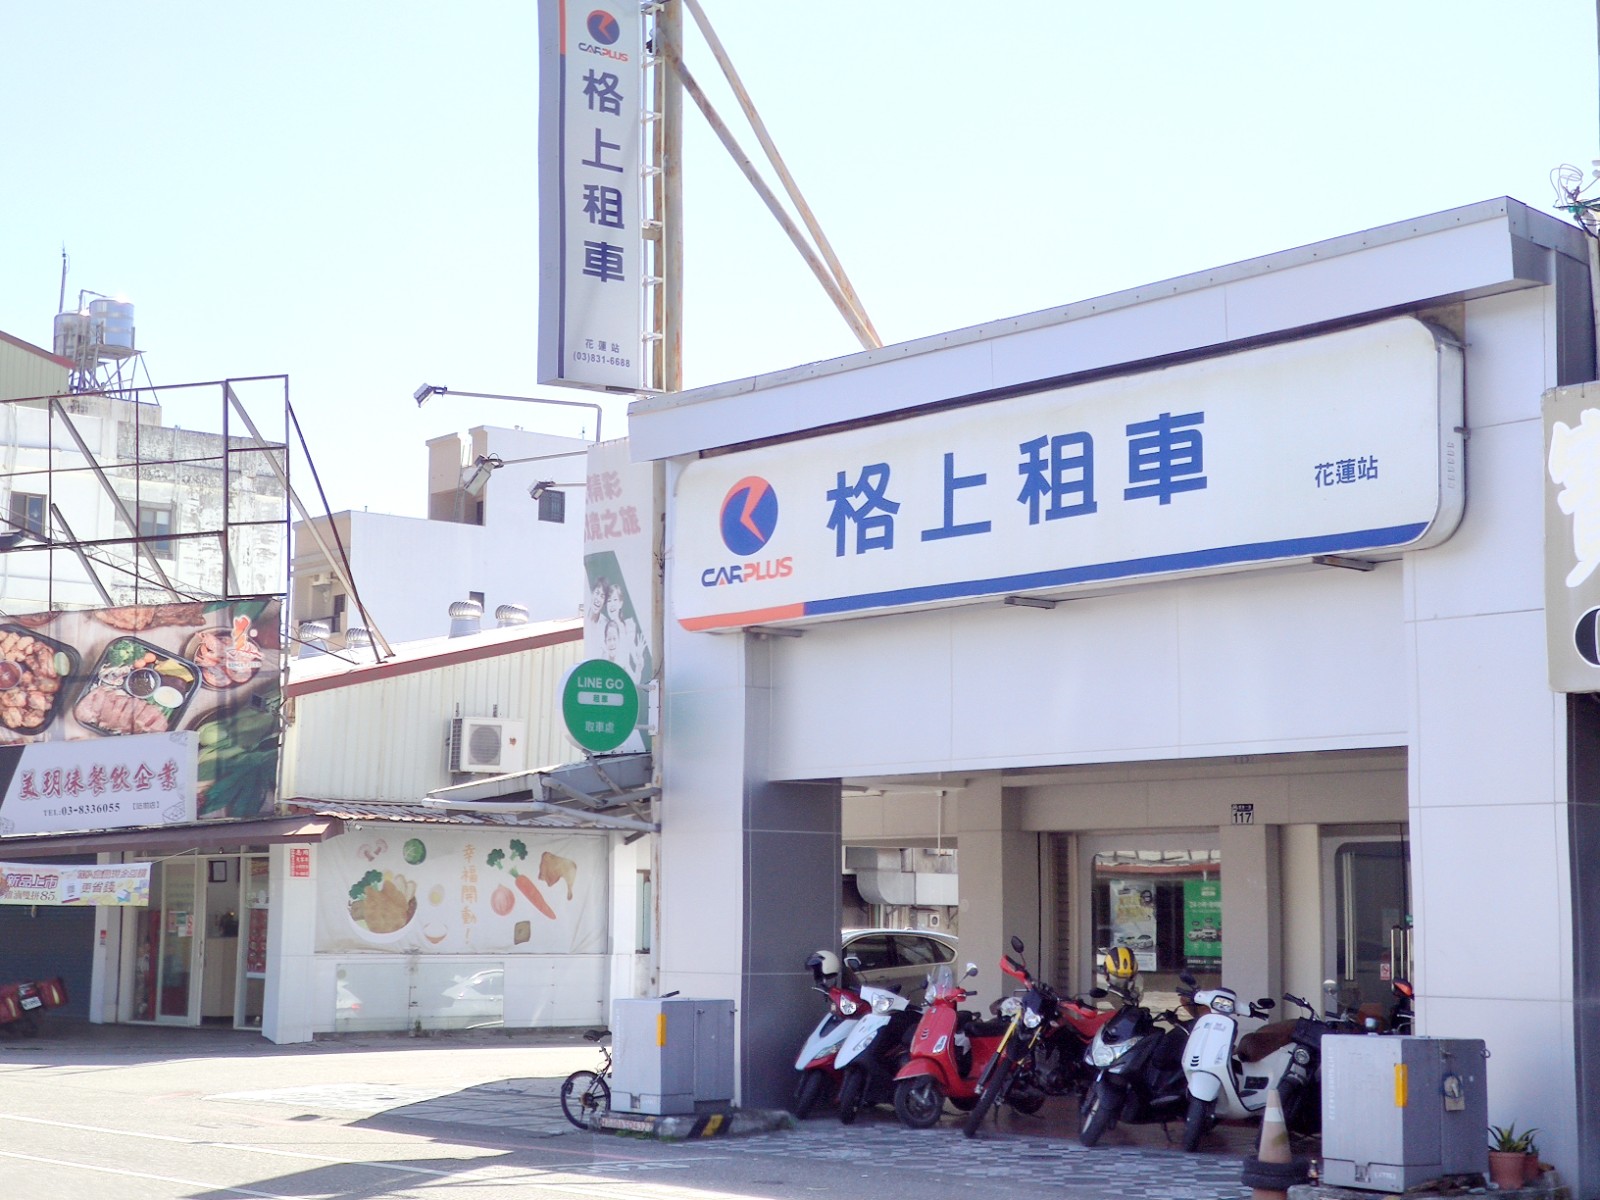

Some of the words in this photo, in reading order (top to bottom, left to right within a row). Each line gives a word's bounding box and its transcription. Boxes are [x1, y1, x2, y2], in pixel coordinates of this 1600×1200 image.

[578, 42, 629, 62] CARPLUS
[581, 68, 625, 283] 格上租車
[585, 338, 620, 353] 花蓮站
[573, 351, 631, 368] (03)831-6688
[1313, 455, 1379, 489] 花蓮站
[825, 411, 1209, 557] 格上租車
[701, 555, 793, 588] CARPLUS
[577, 677, 602, 689] LINE
[605, 678, 624, 690] GO
[1233, 812, 1252, 823] 117
[6, 873, 59, 889] 新品上市
